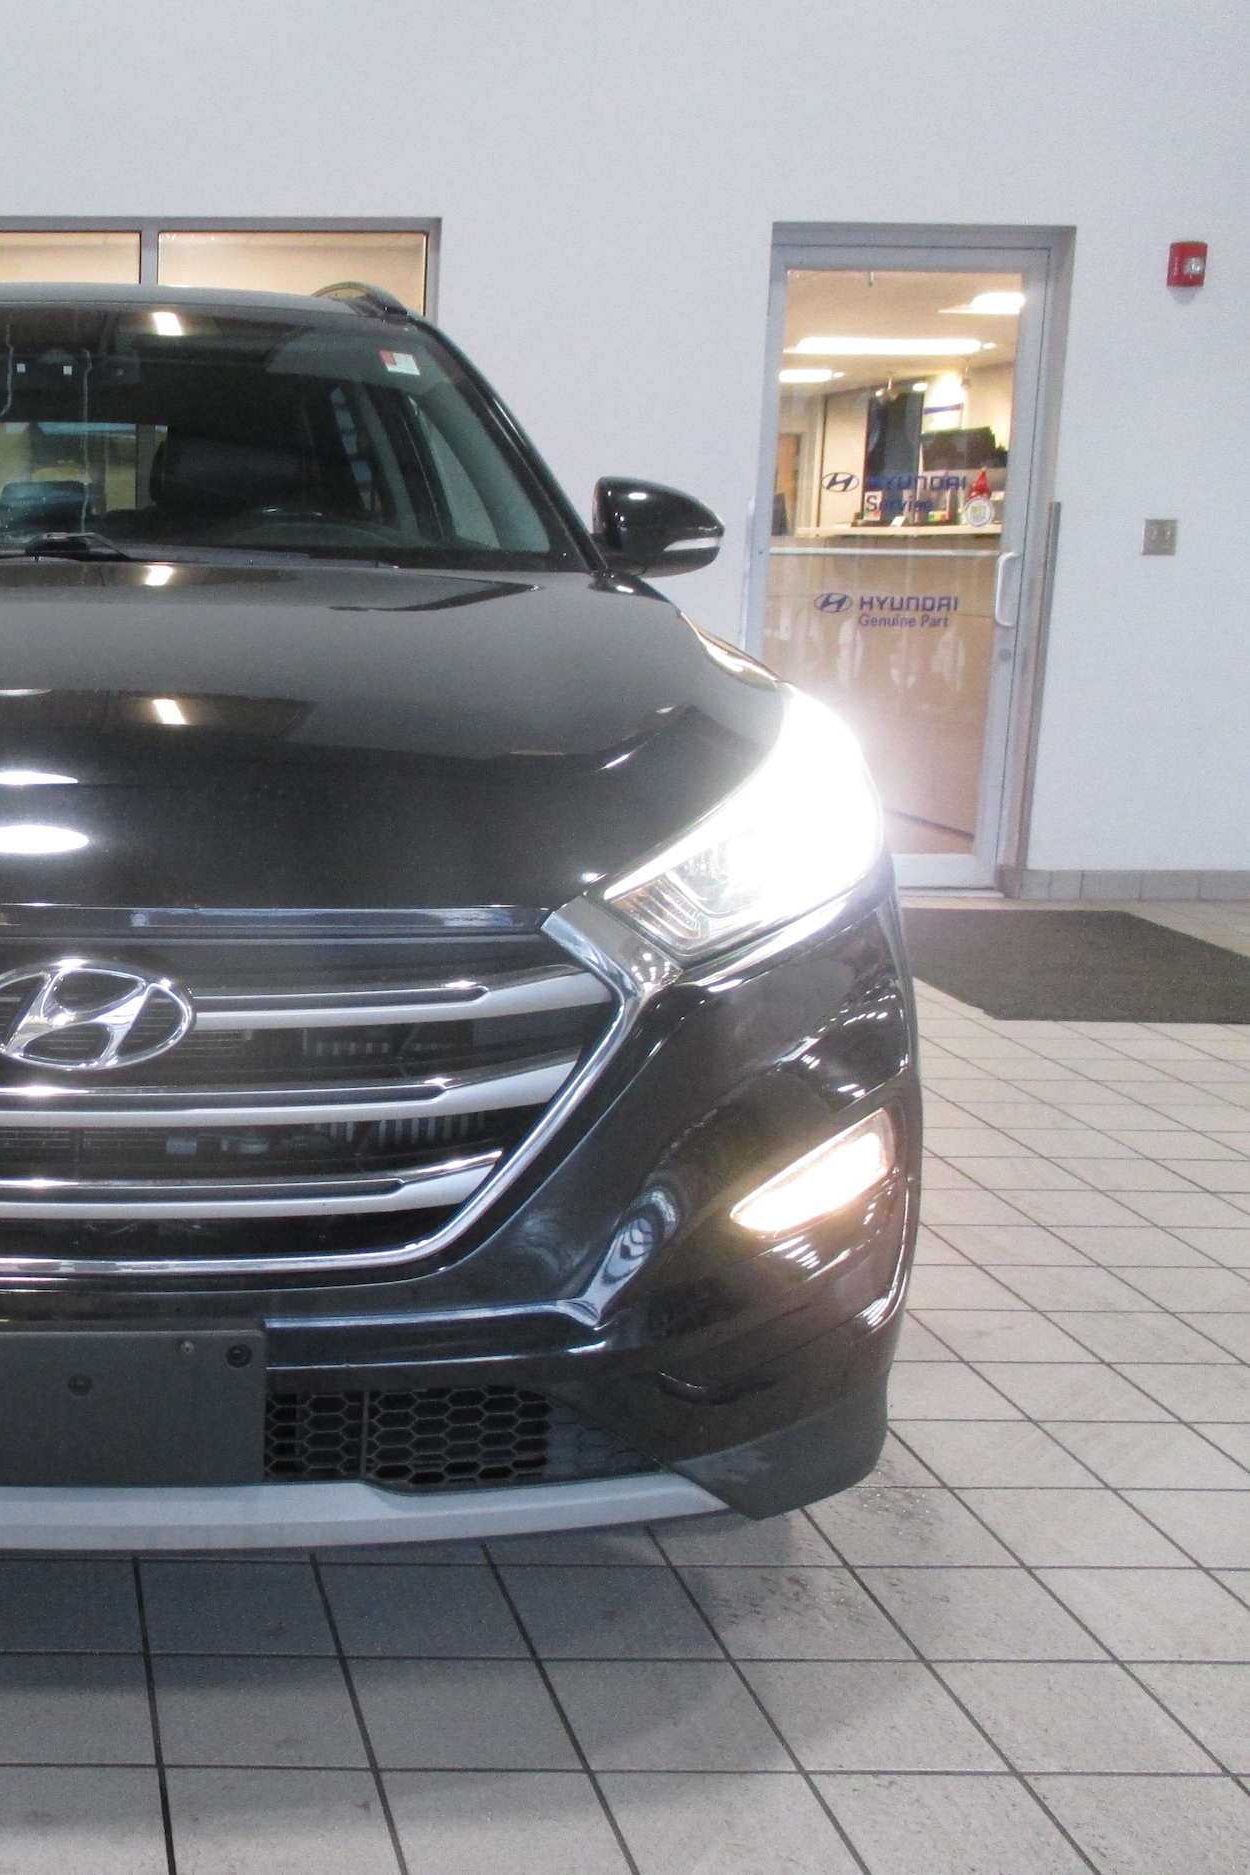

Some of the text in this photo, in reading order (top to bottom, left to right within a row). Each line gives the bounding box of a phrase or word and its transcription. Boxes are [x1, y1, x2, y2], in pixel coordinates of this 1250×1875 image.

[859, 596, 959, 612] HYUNDAI
[859, 613, 950, 628] Genuine Part
